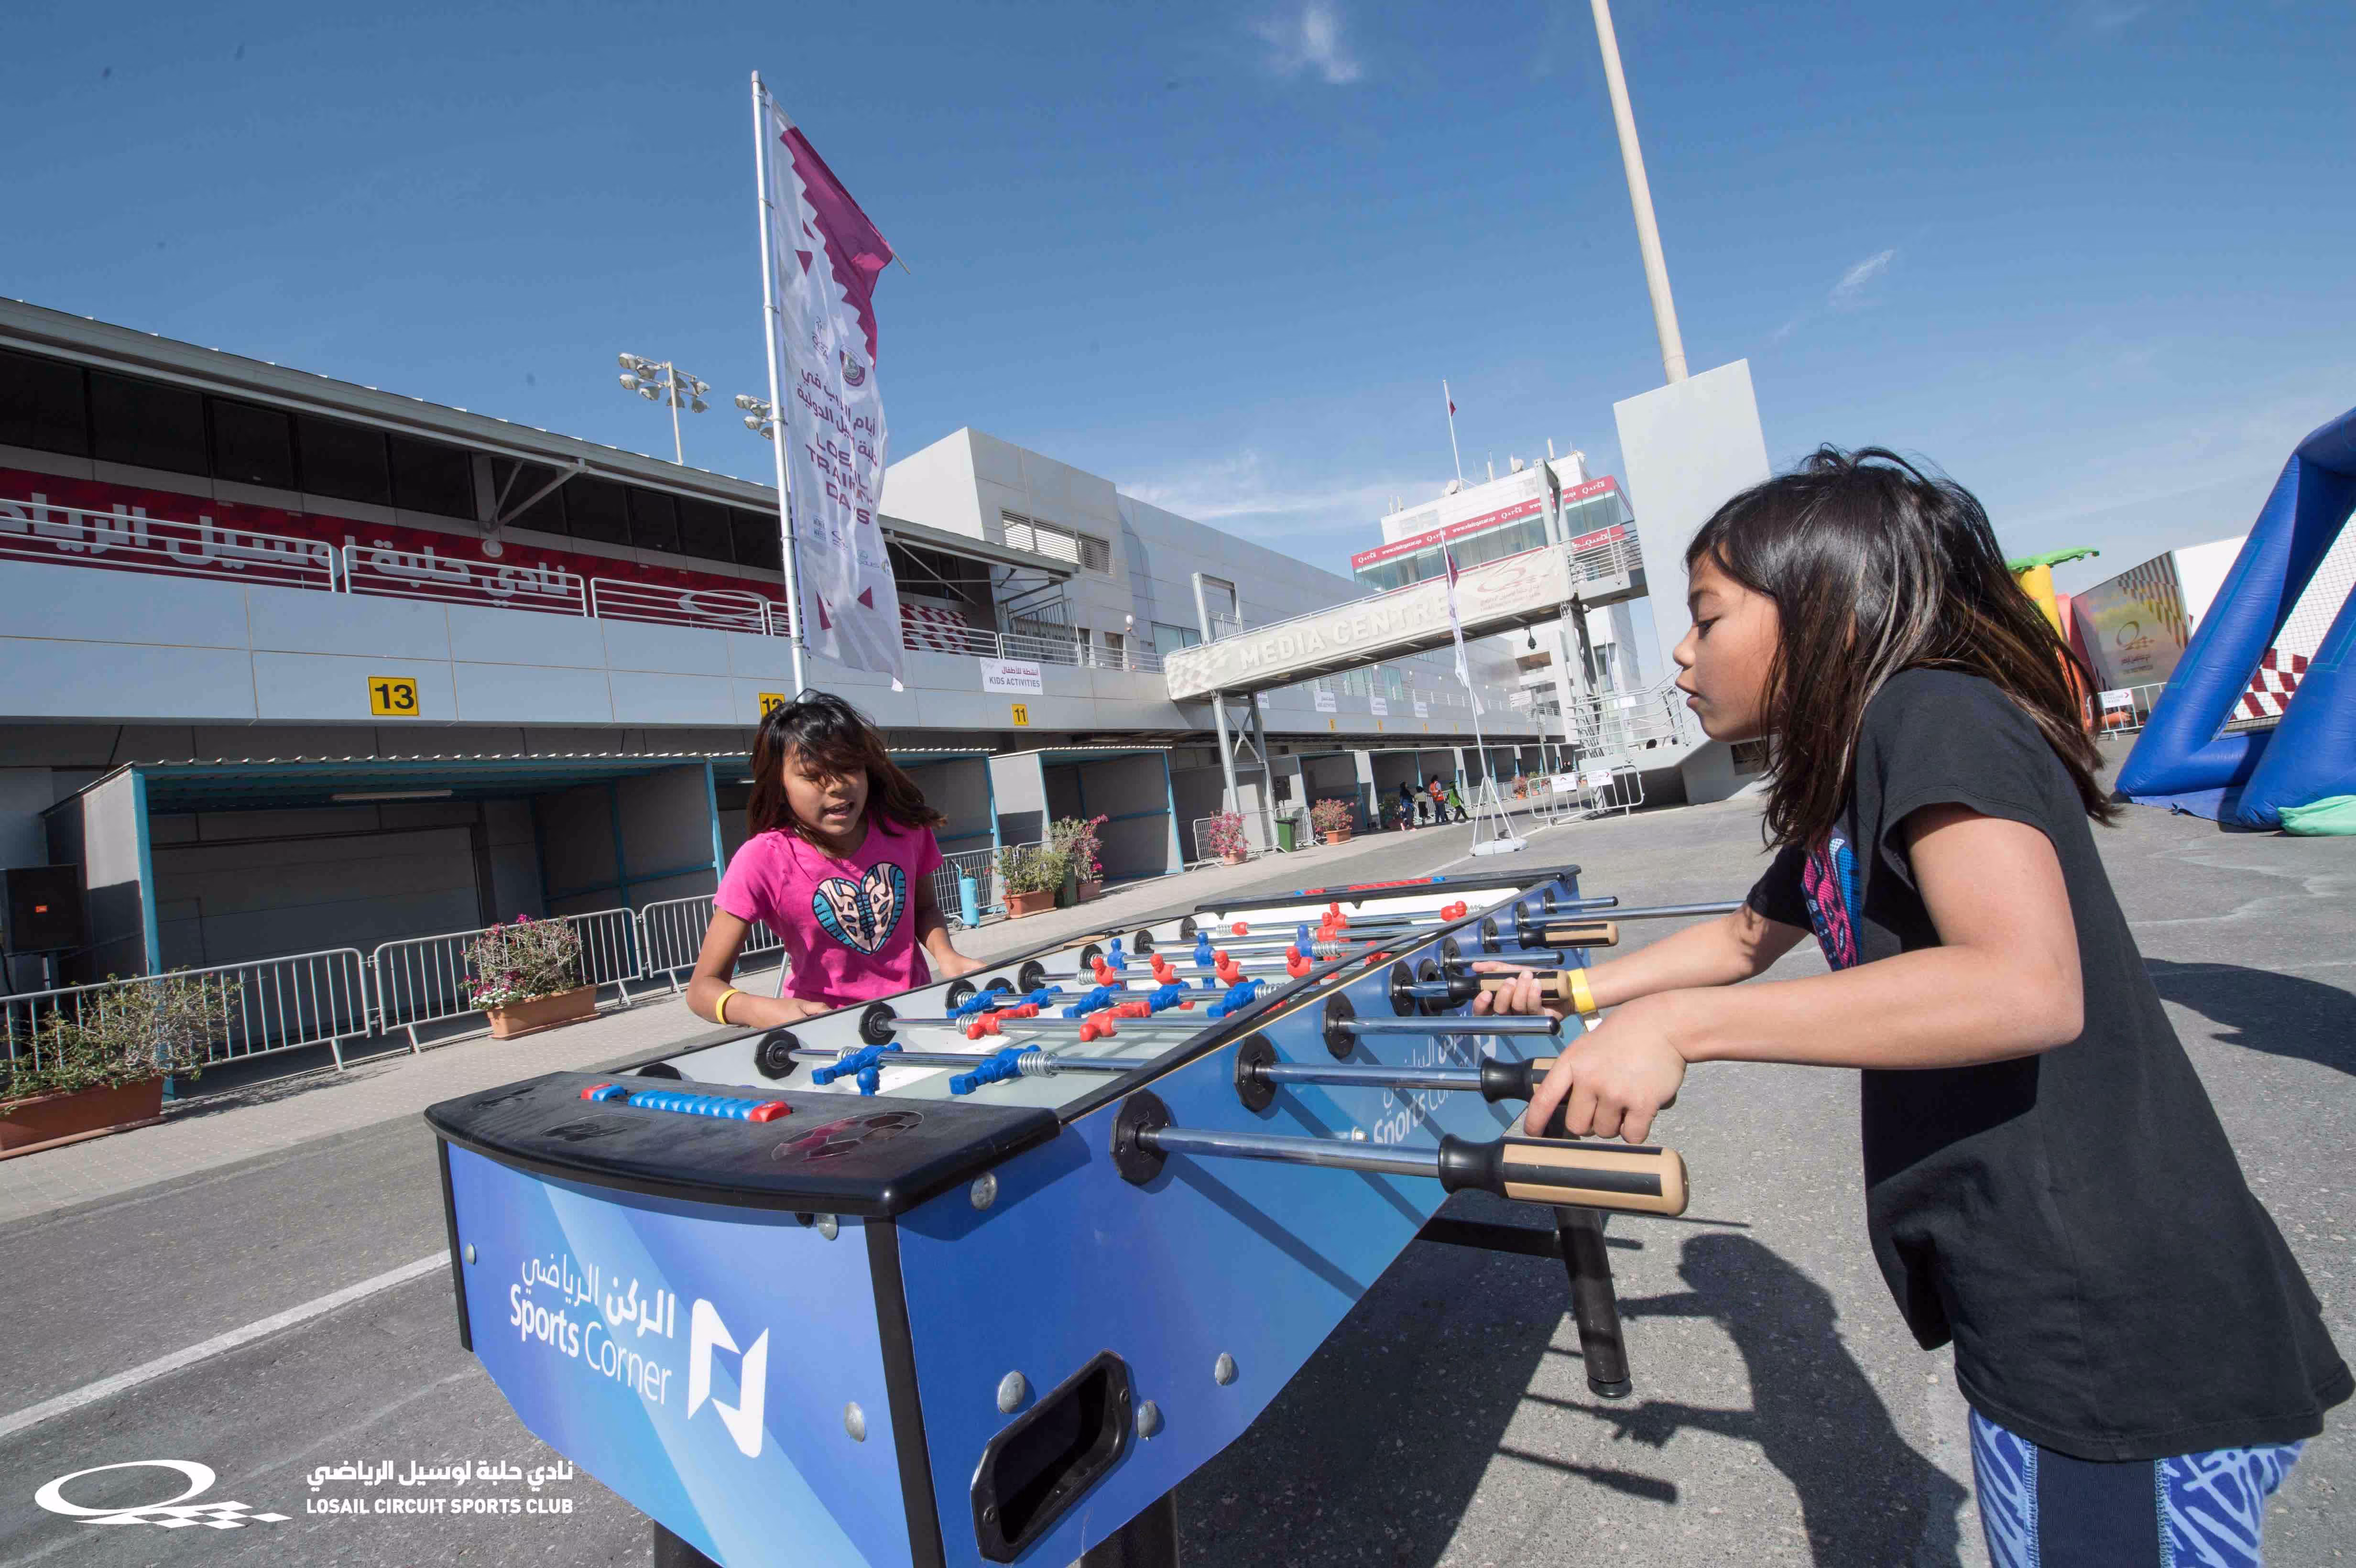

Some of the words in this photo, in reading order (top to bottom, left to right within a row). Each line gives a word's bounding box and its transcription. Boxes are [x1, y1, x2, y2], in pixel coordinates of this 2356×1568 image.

[0, 492, 149, 554] الريا
[826, 480, 870, 525] DAS
[1239, 626, 1327, 669] MEDIA
[1333, 596, 1450, 645] CENTRE
[375, 684, 414, 709] 13
[989, 676, 1005, 685] KIDS
[1006, 678, 1040, 687] ACTIVITIES
[1014, 708, 1026, 722] 11
[522, 1252, 600, 1307] الرياضي
[606, 1276, 675, 1339] الركن
[510, 1284, 579, 1358] Sports
[585, 1321, 672, 1405] Corner
